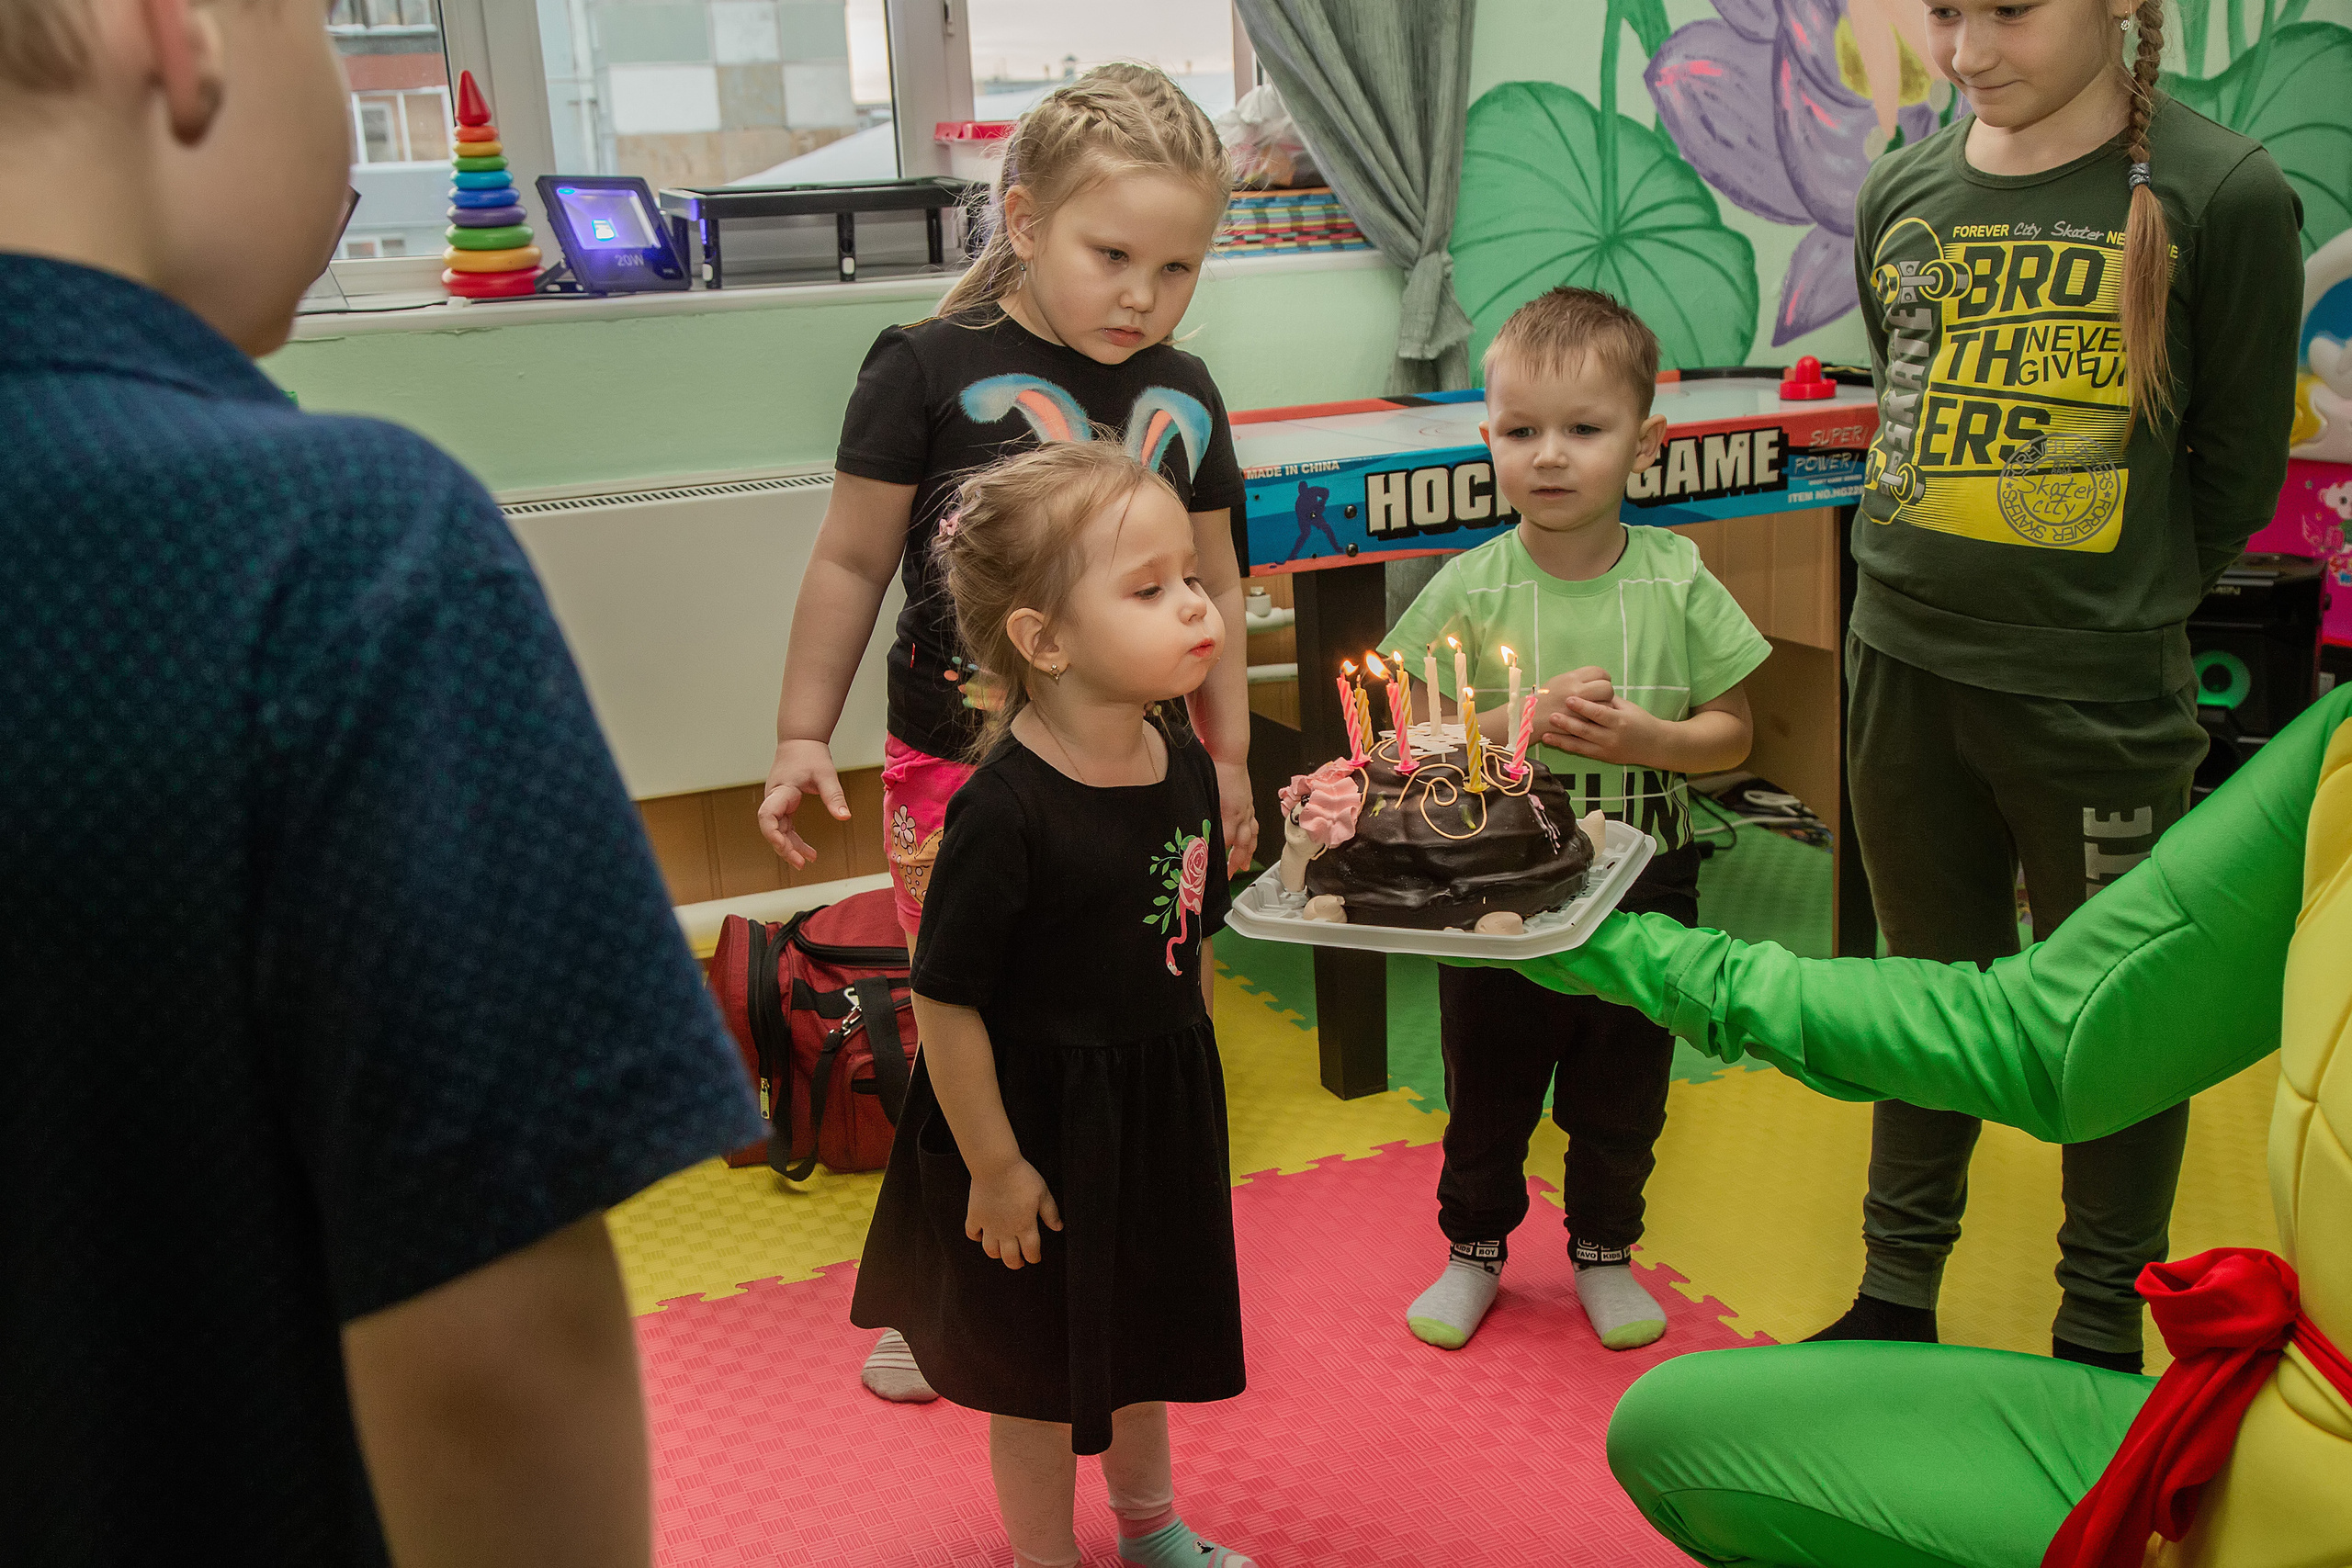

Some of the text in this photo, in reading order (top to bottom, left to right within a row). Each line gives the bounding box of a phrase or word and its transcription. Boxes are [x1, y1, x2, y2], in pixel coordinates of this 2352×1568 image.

[1952, 224, 2009, 238] FOREVER
[2013, 222, 2041, 240] City
[2051, 220, 2105, 242] Skater
[614, 254, 644, 266] 20W
[1958, 243, 2107, 320] BRO
[2026, 325, 2121, 353] NEVE
[1946, 326, 2029, 387] TH
[2018, 349, 2098, 386] GIVE
[1809, 424, 1863, 446] SUPER
[1917, 395, 2052, 466] ERS
[1246, 460, 1340, 479] MADE IN CHINA
[1794, 452, 1852, 474] POWER
[2005, 440, 2065, 481] FOREVER
[1367, 429, 1781, 534] HOC GAME
[1788, 491, 1814, 503] ITEM
[2017, 467, 2097, 500] Skater
[2003, 489, 2112, 542] SKATERS FOREVER
